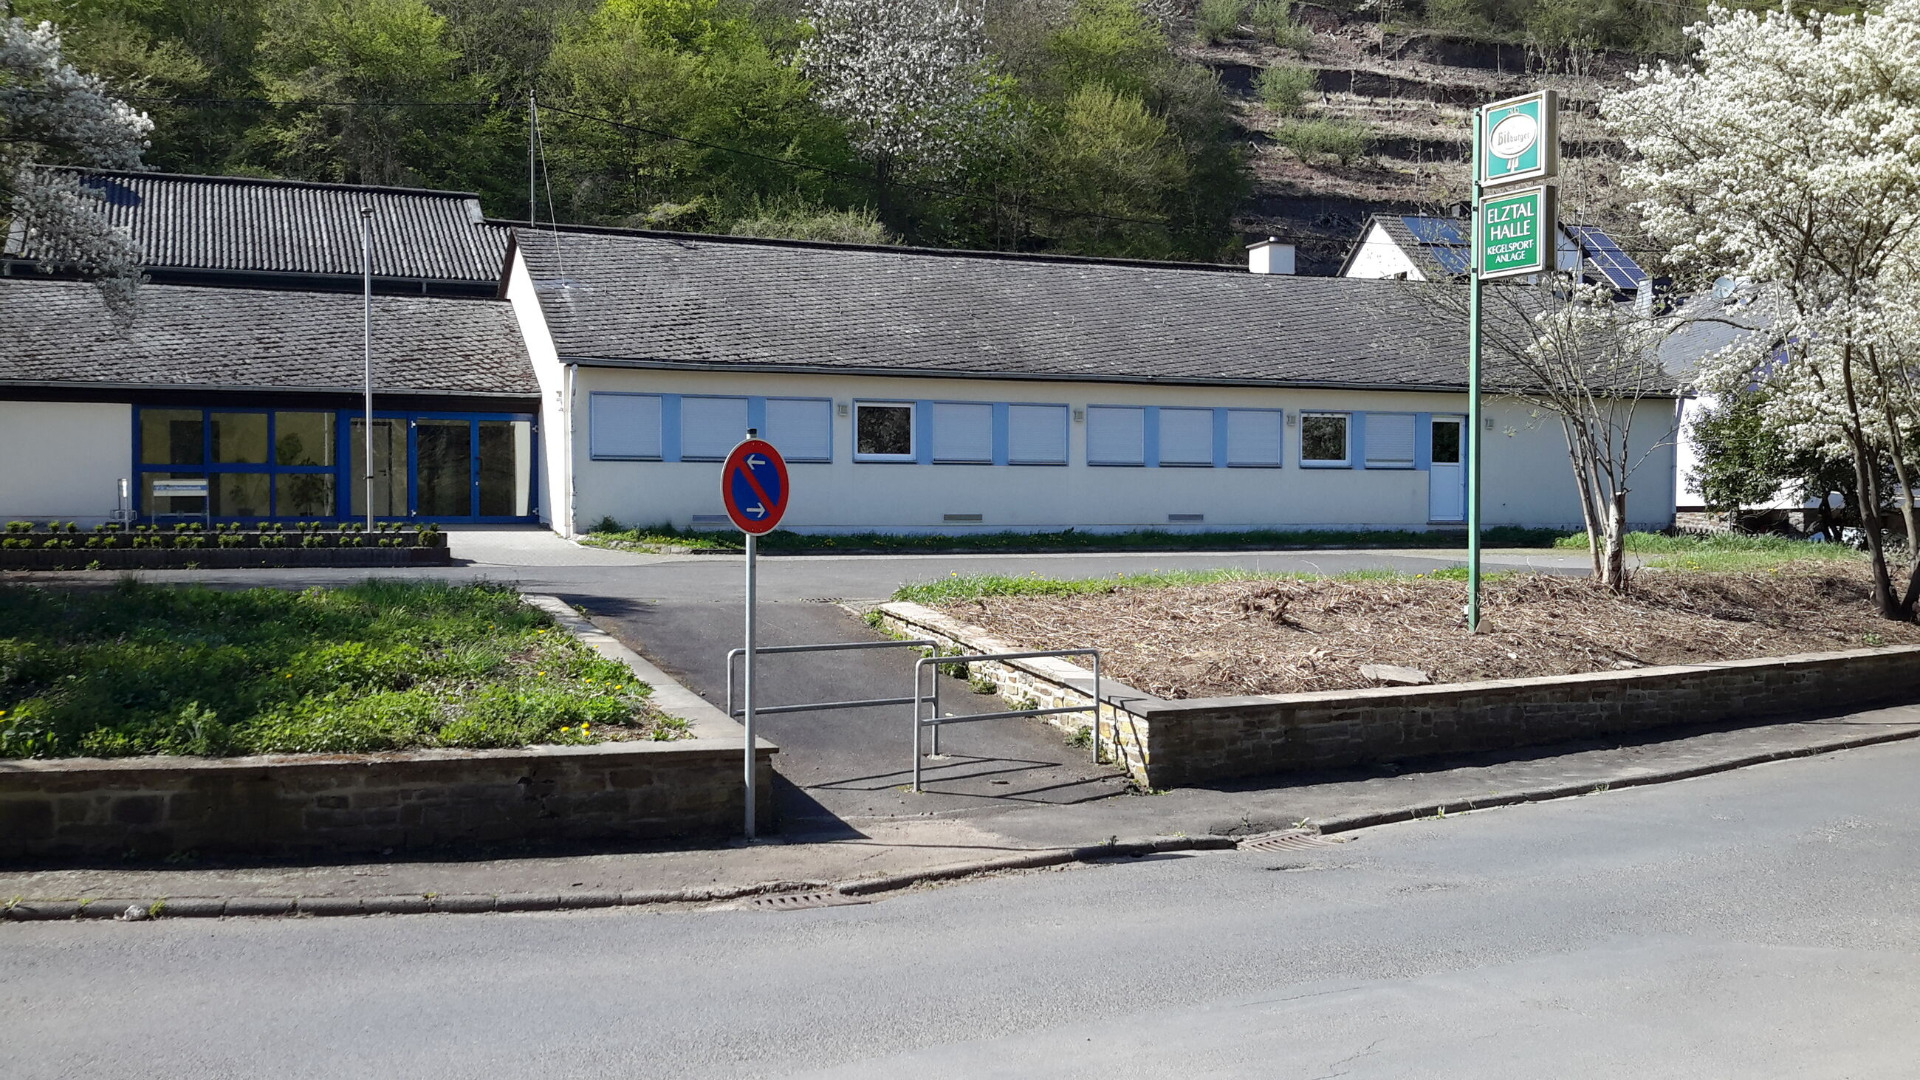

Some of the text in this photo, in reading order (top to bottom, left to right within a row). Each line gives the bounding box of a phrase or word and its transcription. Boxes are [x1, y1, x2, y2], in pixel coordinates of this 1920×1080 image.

[1487, 202, 1534, 224] ELZTAL
[1490, 220, 1531, 241] HALLE
[1487, 239, 1534, 255] KEGELSPORT-
[1495, 251, 1525, 264] ANLAGE
